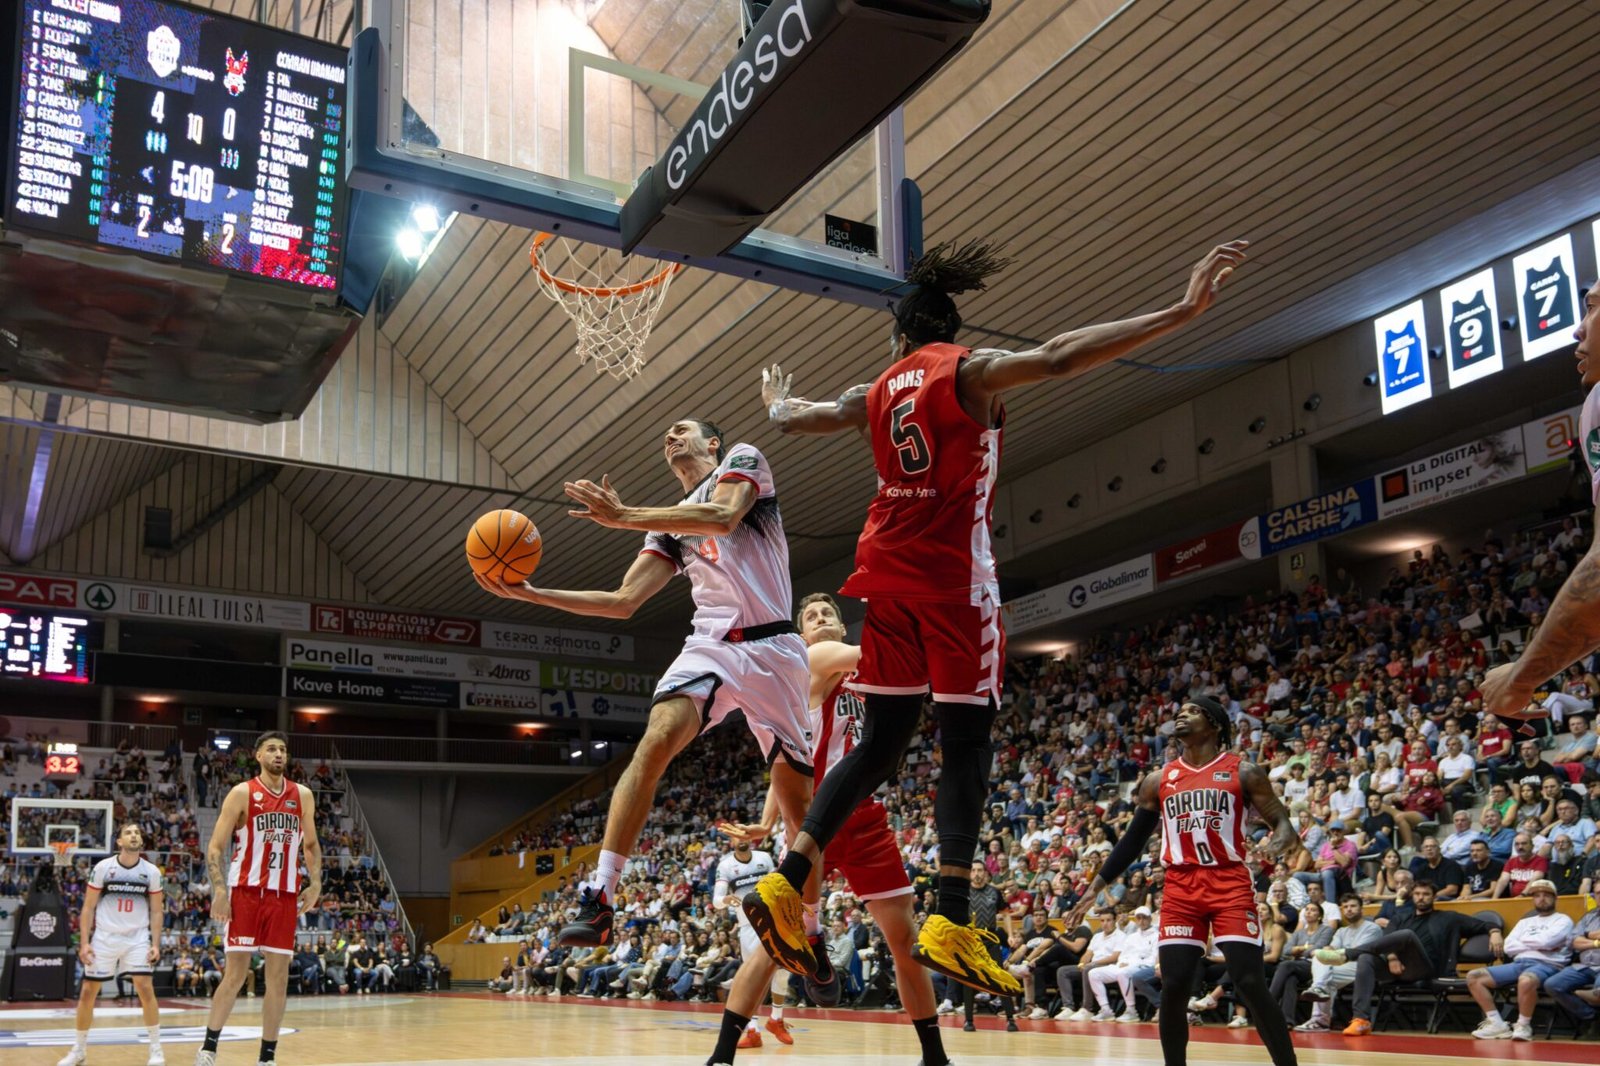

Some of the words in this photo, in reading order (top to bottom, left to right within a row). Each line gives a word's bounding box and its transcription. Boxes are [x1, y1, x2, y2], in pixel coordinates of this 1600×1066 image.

[151, 91, 165, 124] 4
[667, 0, 813, 190] endesa
[222, 107, 237, 141] 0
[170, 159, 215, 204] 5:09
[137, 205, 151, 238] 2
[827, 225, 849, 240] liga
[221, 223, 235, 254] 2
[1535, 285, 1558, 318] 7
[1459, 318, 1483, 347] 9
[1394, 347, 1410, 375] 7
[888, 369, 924, 396] PONS
[891, 398, 931, 475] 5
[1411, 465, 1426, 476] La
[1430, 442, 1486, 470] DIGITAL
[1413, 465, 1473, 494] impser
[1267, 486, 1360, 528] CALSINA
[1090, 567, 1150, 594] Globalimar
[158, 593, 206, 619] LLEAL
[348, 609, 436, 627] EQUIPACIONS
[353, 620, 431, 636] ESPORTIVES
[291, 643, 373, 667] Panella
[488, 663, 532, 682] Abras
[293, 677, 333, 693] Kave
[338, 681, 384, 697] Home
[49, 756, 78, 773] 3.2
[1165, 789, 1230, 819] GIRONA
[256, 812, 299, 832] GIRONA
[268, 851, 284, 869] 21
[1196, 841, 1214, 865] 0
[117, 898, 134, 912] 10
[1164, 926, 1194, 937] YOSOY
[20, 957, 63, 967] BeGreat
